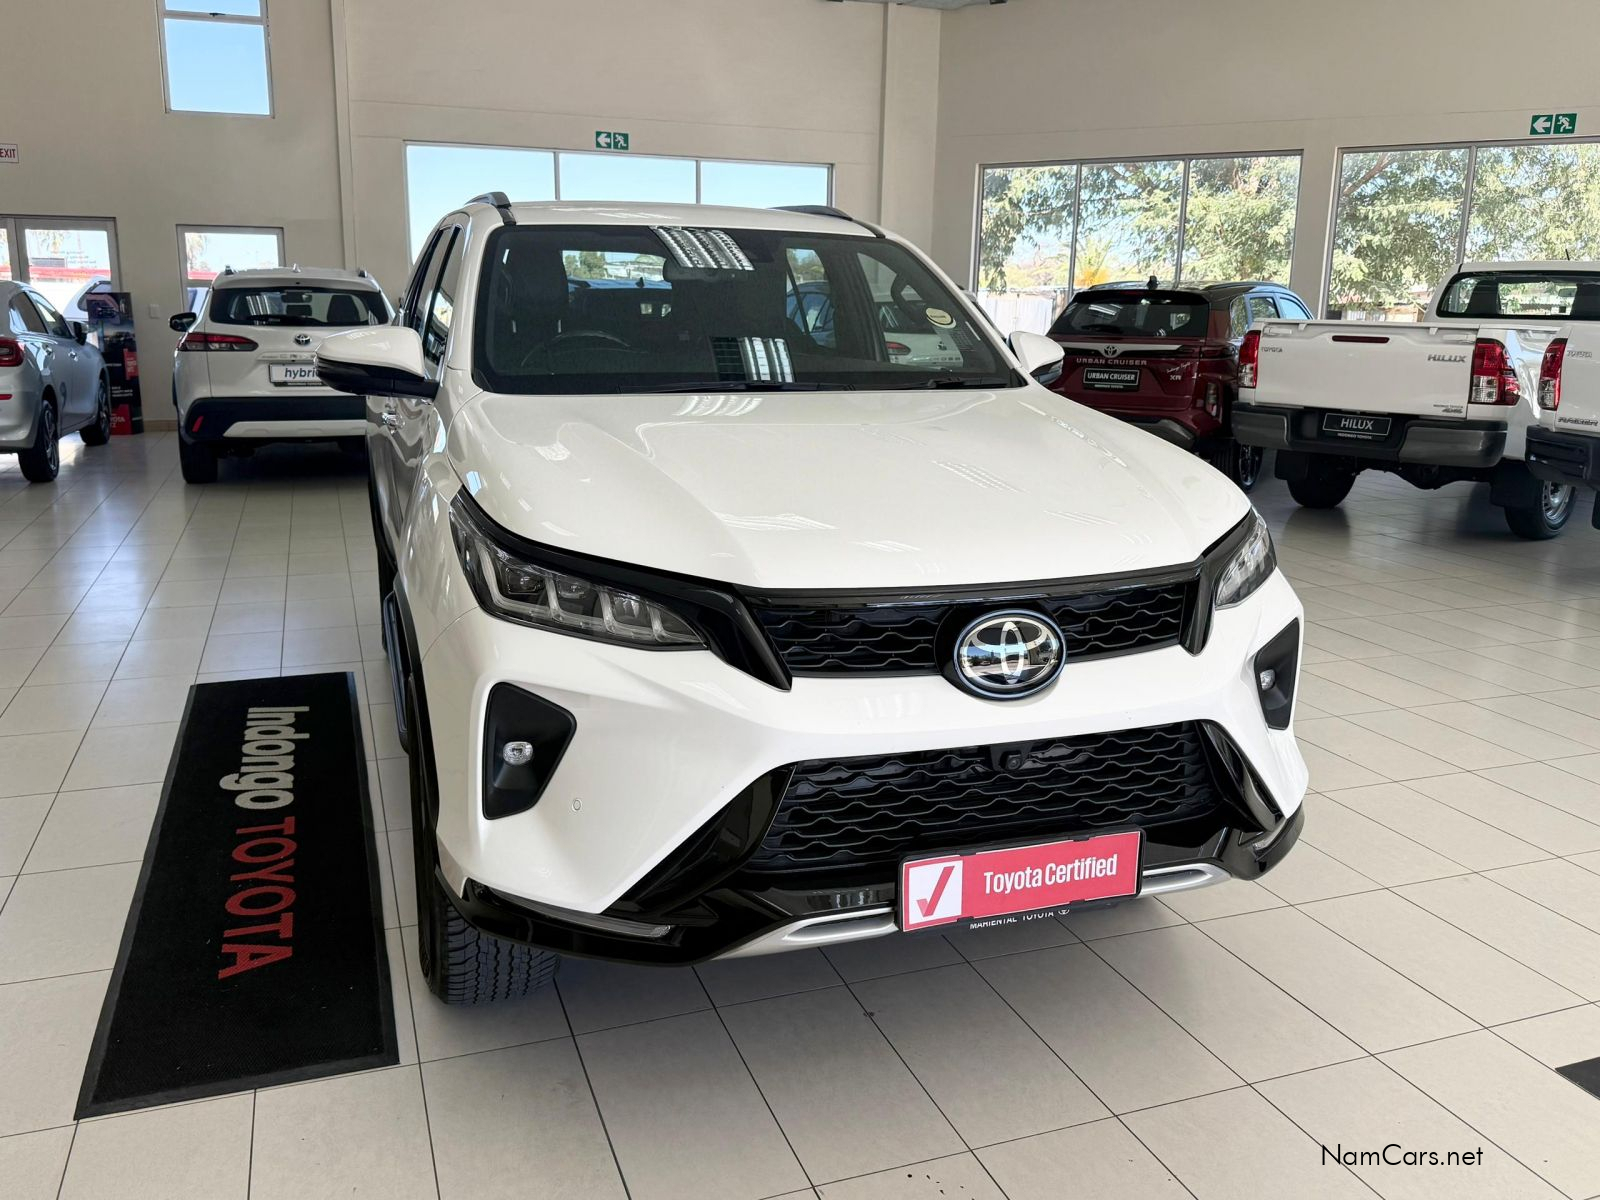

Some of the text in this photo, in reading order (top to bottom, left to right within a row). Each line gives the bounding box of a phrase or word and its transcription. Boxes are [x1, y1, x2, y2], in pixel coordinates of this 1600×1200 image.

[1427, 354, 1466, 363] HILUX
[1087, 372, 1135, 381] URBAN CRUISER
[1340, 418, 1374, 430] HILUX
[218, 705, 310, 980] Indongo TOYOTA
[983, 853, 1118, 895] Toyota Certified
